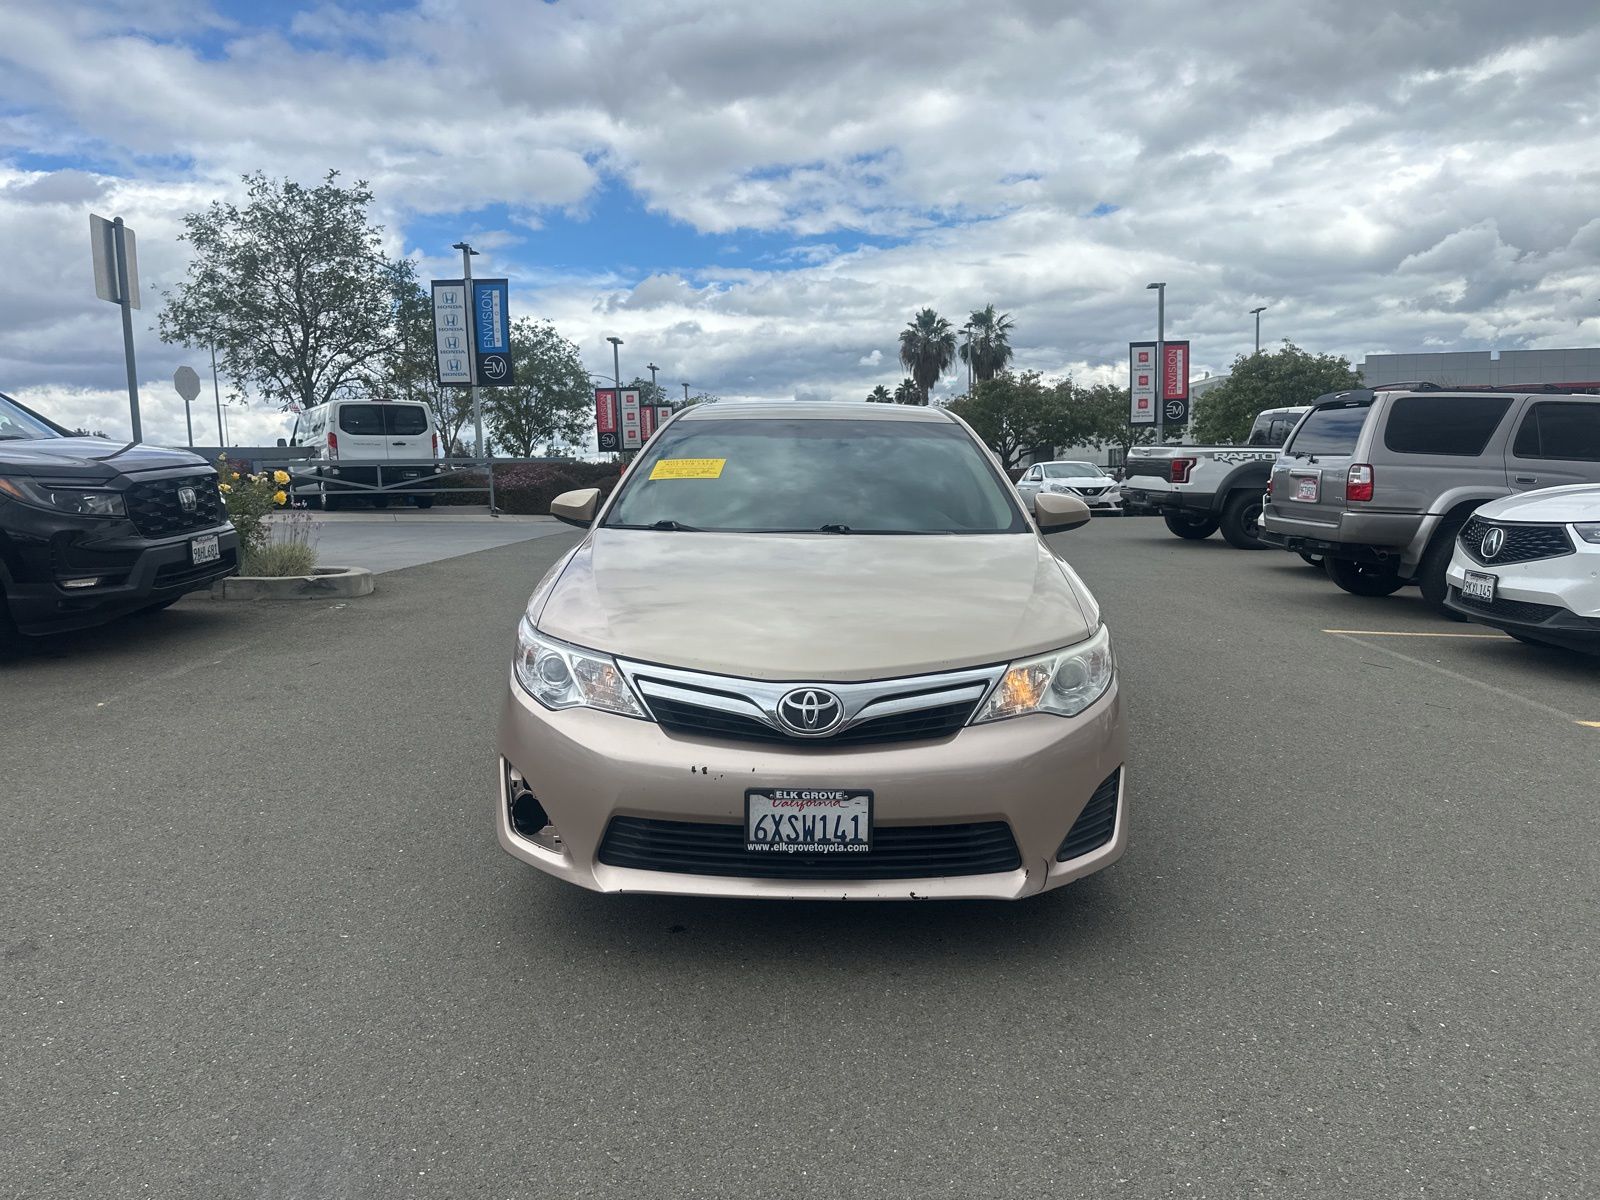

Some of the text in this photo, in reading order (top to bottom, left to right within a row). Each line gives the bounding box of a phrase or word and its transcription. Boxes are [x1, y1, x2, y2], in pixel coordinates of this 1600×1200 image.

[481, 289, 494, 348] ENVISION
[1167, 349, 1177, 395] ENVISION
[1213, 452, 1277, 465] RAPTO
[776, 791, 843, 800] ELK GROVE
[753, 814, 864, 842] 6XSW141
[747, 843, 869, 854] www.elkgrovetoyota.com
